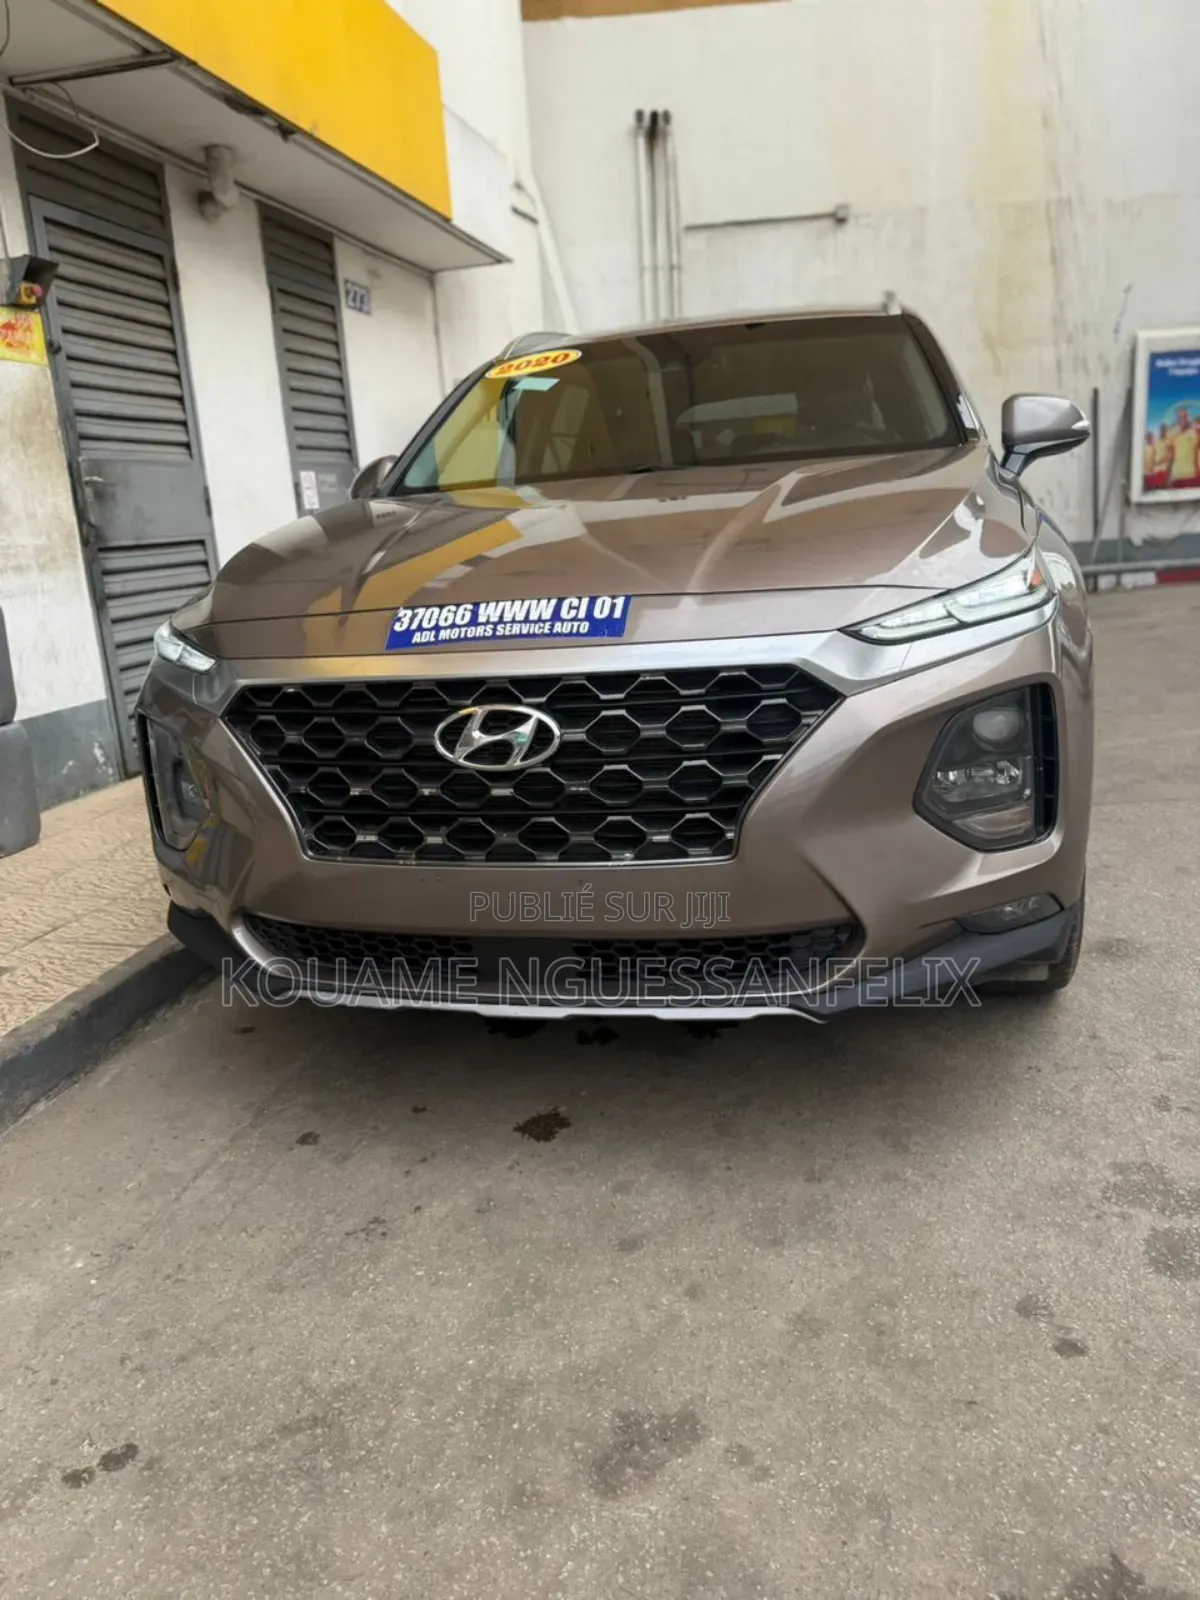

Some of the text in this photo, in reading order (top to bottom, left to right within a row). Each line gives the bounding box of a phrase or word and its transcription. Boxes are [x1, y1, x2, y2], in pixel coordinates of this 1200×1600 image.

[495, 353, 570, 375] 2020
[393, 595, 626, 632] 37066 WWW CI 01
[411, 620, 590, 645] ADL MOTORS SERVICE AUTO
